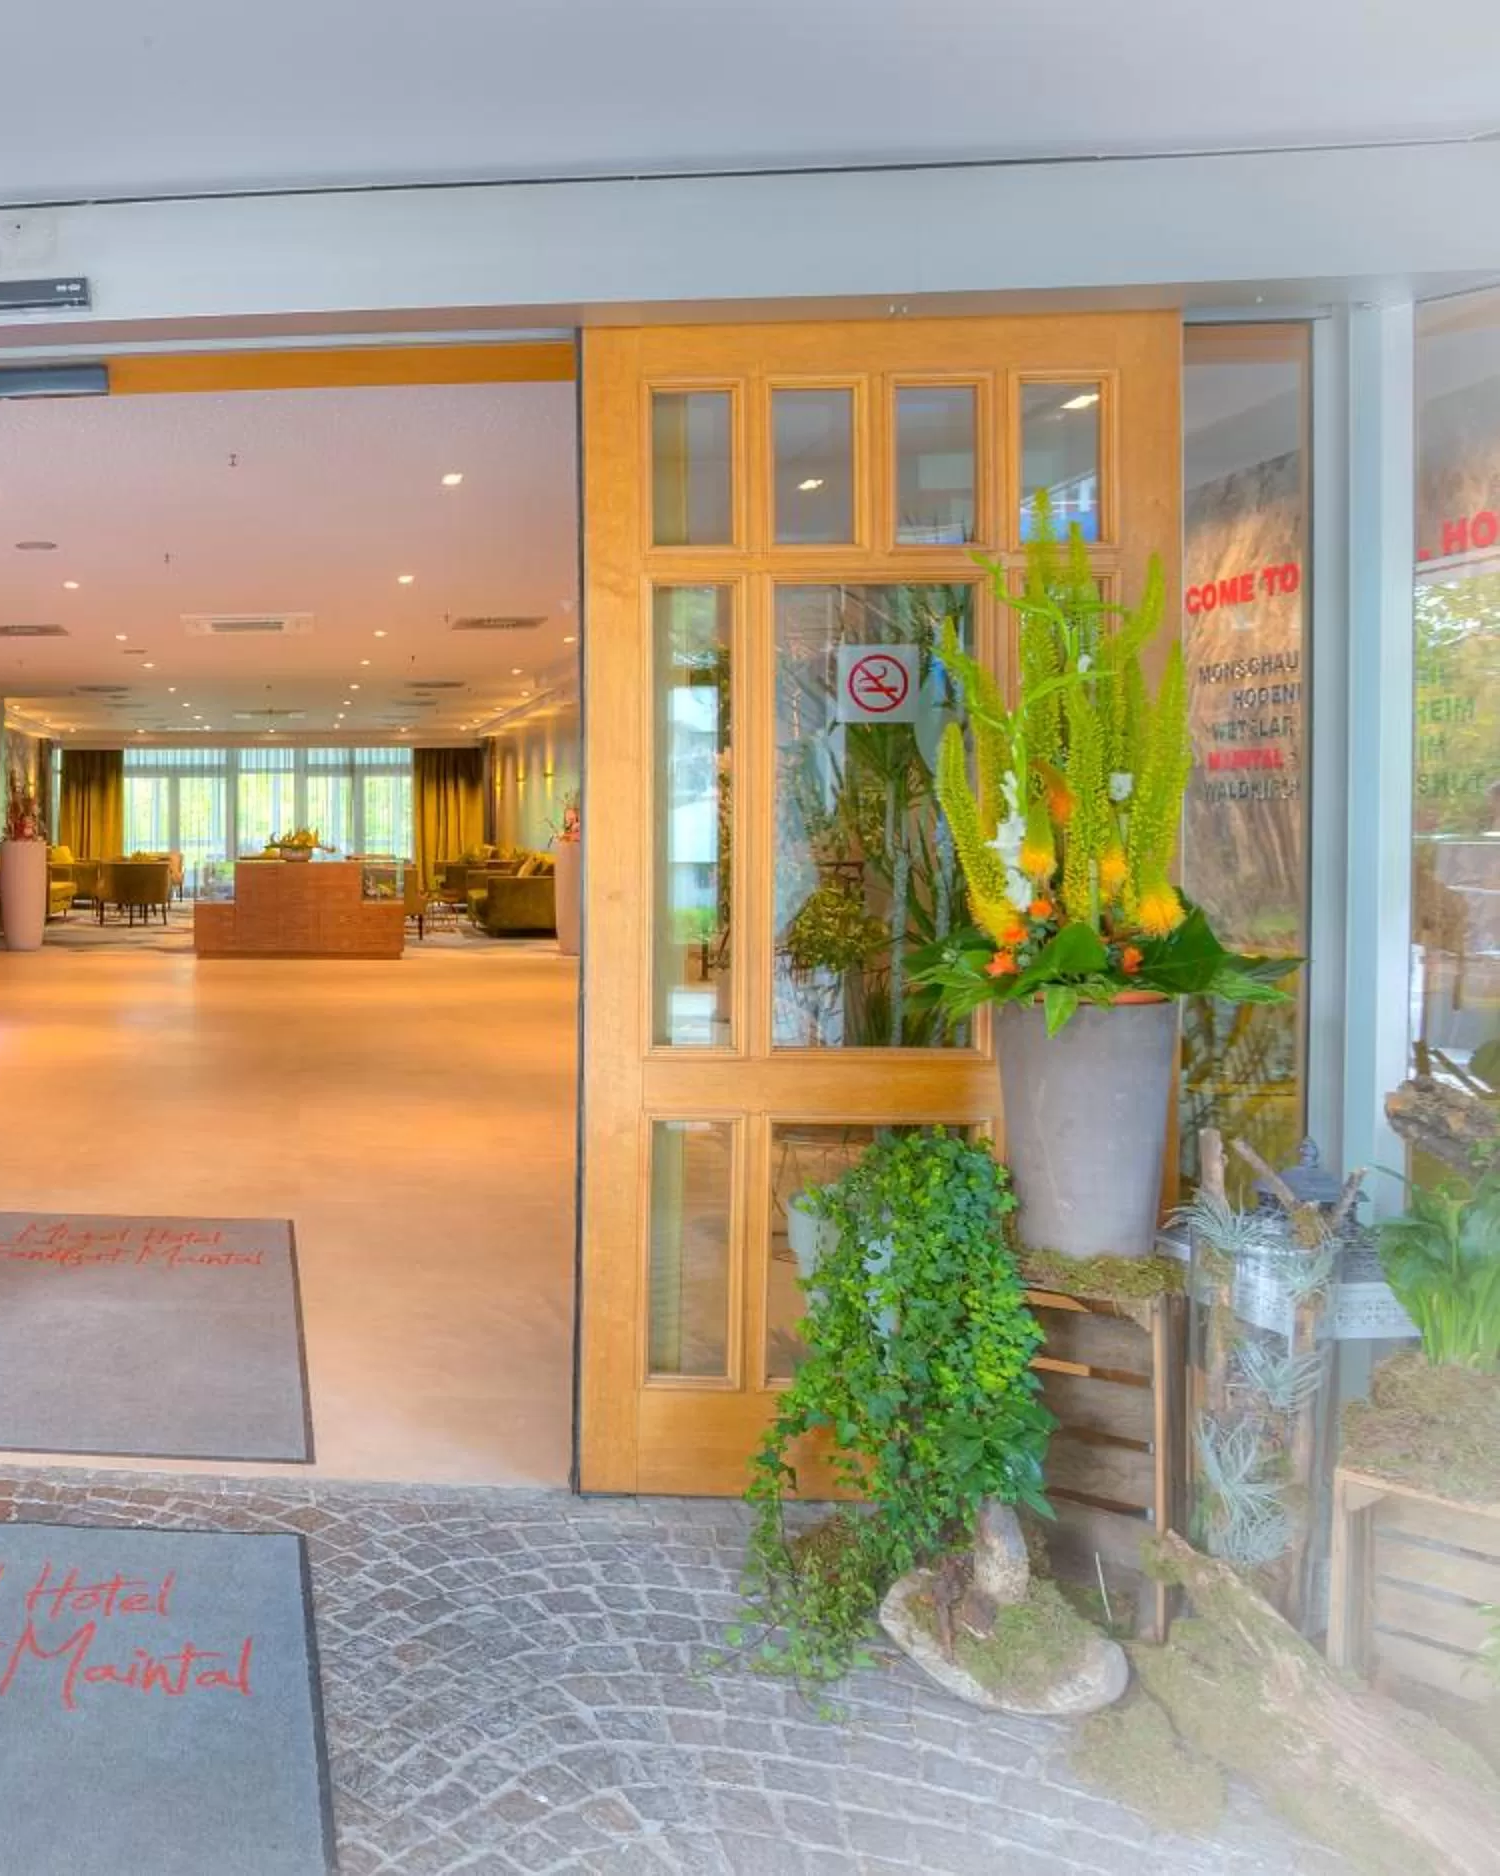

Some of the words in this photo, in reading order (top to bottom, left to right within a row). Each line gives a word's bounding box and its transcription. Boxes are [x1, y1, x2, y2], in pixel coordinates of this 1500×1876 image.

[1186, 571, 1254, 615] COME
[1261, 562, 1300, 596] TO
[1198, 649, 1300, 685] MONSCHAU
[26, 1557, 178, 1620] Hotel
